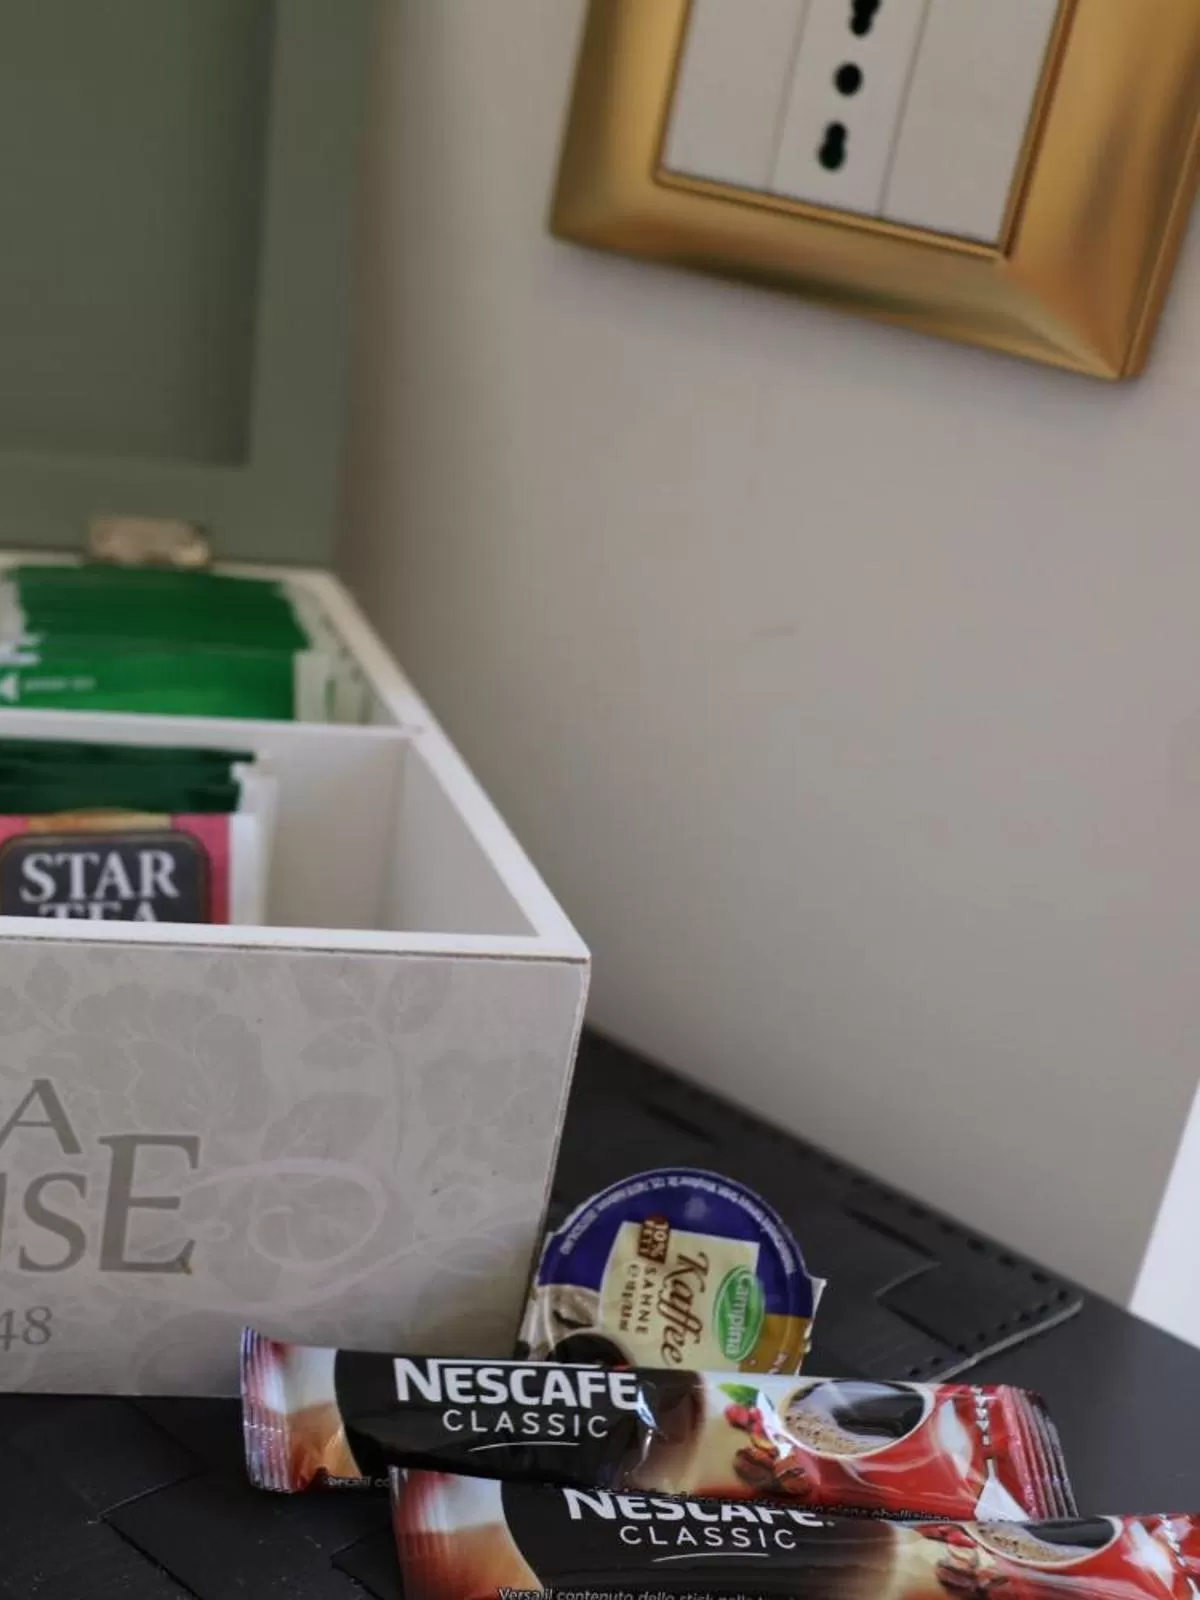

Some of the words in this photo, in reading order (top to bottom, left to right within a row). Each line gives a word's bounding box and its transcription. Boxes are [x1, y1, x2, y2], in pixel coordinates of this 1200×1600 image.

[19, 849, 180, 903] STAR
[636, 1267, 658, 1334] SAHNE
[657, 1251, 709, 1366] Kaffee
[725, 1275, 750, 1355] Campina
[443, 1409, 608, 1438] CLASSIC
[619, 1526, 796, 1549] CLASSIC
